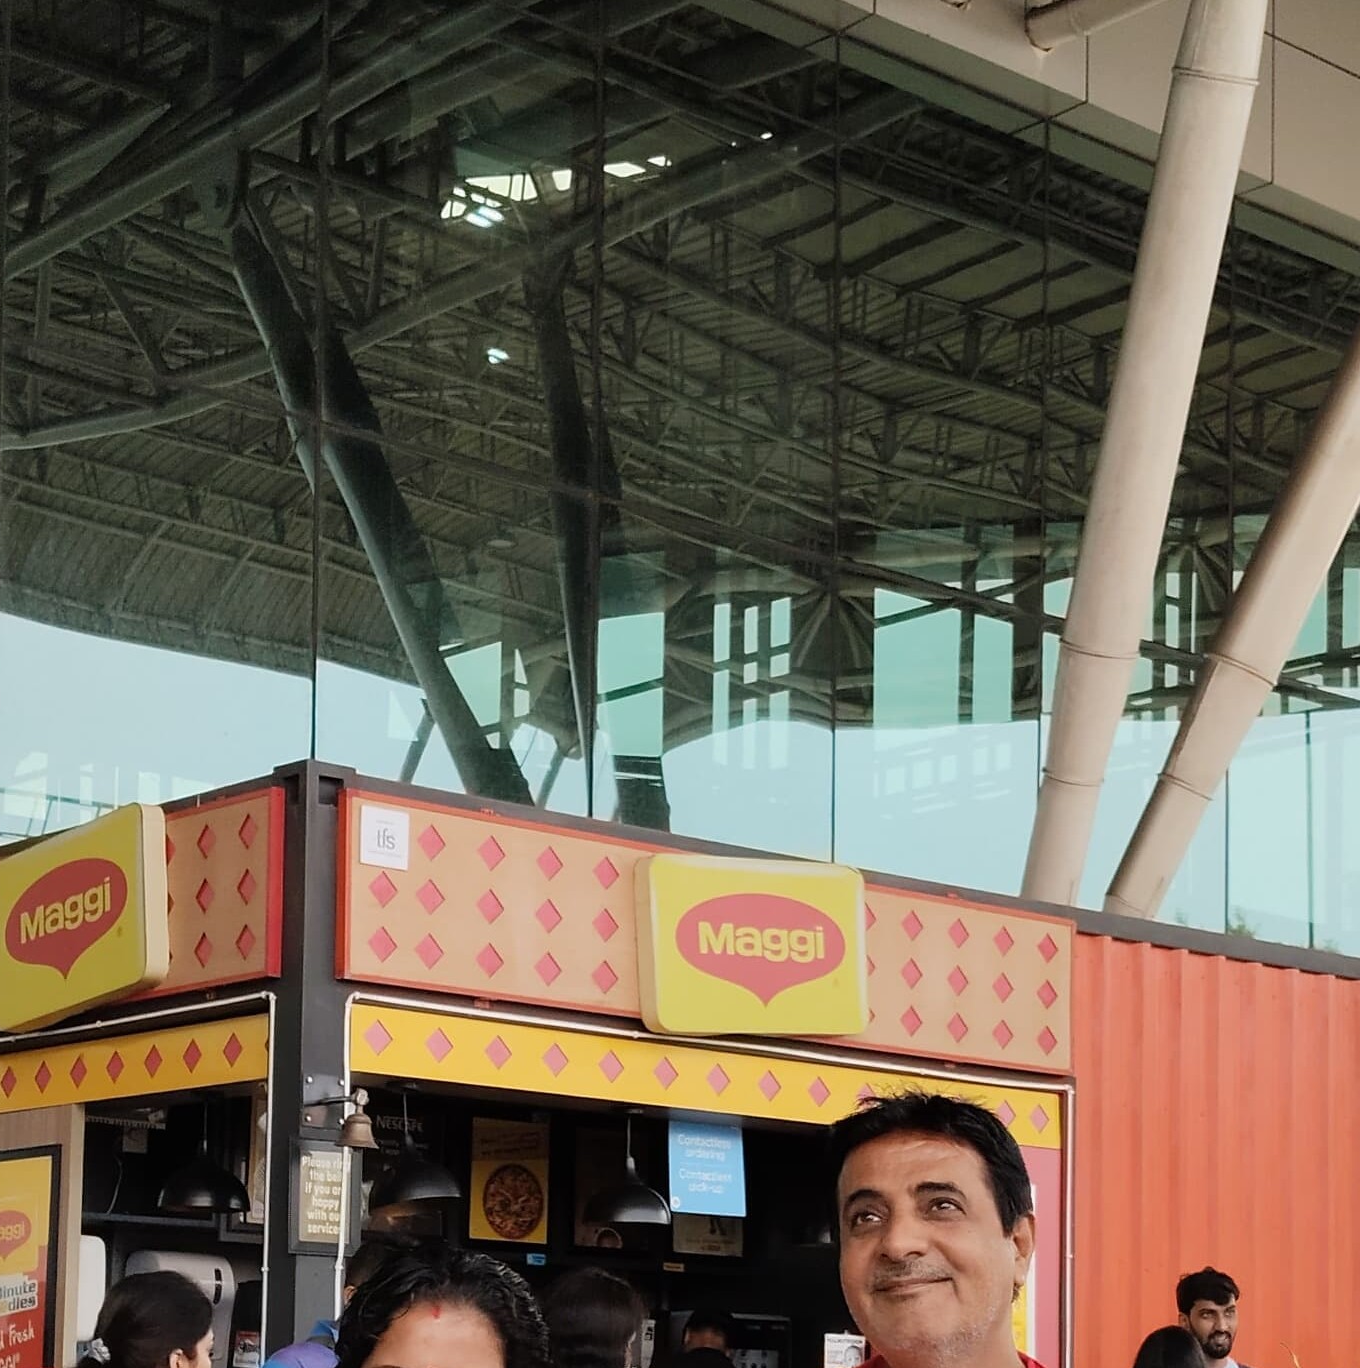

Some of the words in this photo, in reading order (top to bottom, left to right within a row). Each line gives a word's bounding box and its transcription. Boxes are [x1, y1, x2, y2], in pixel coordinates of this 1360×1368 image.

[20, 876, 111, 944] Maggi
[698, 921, 825, 964] Maggi
[9, 1320, 35, 1347] Fresh
